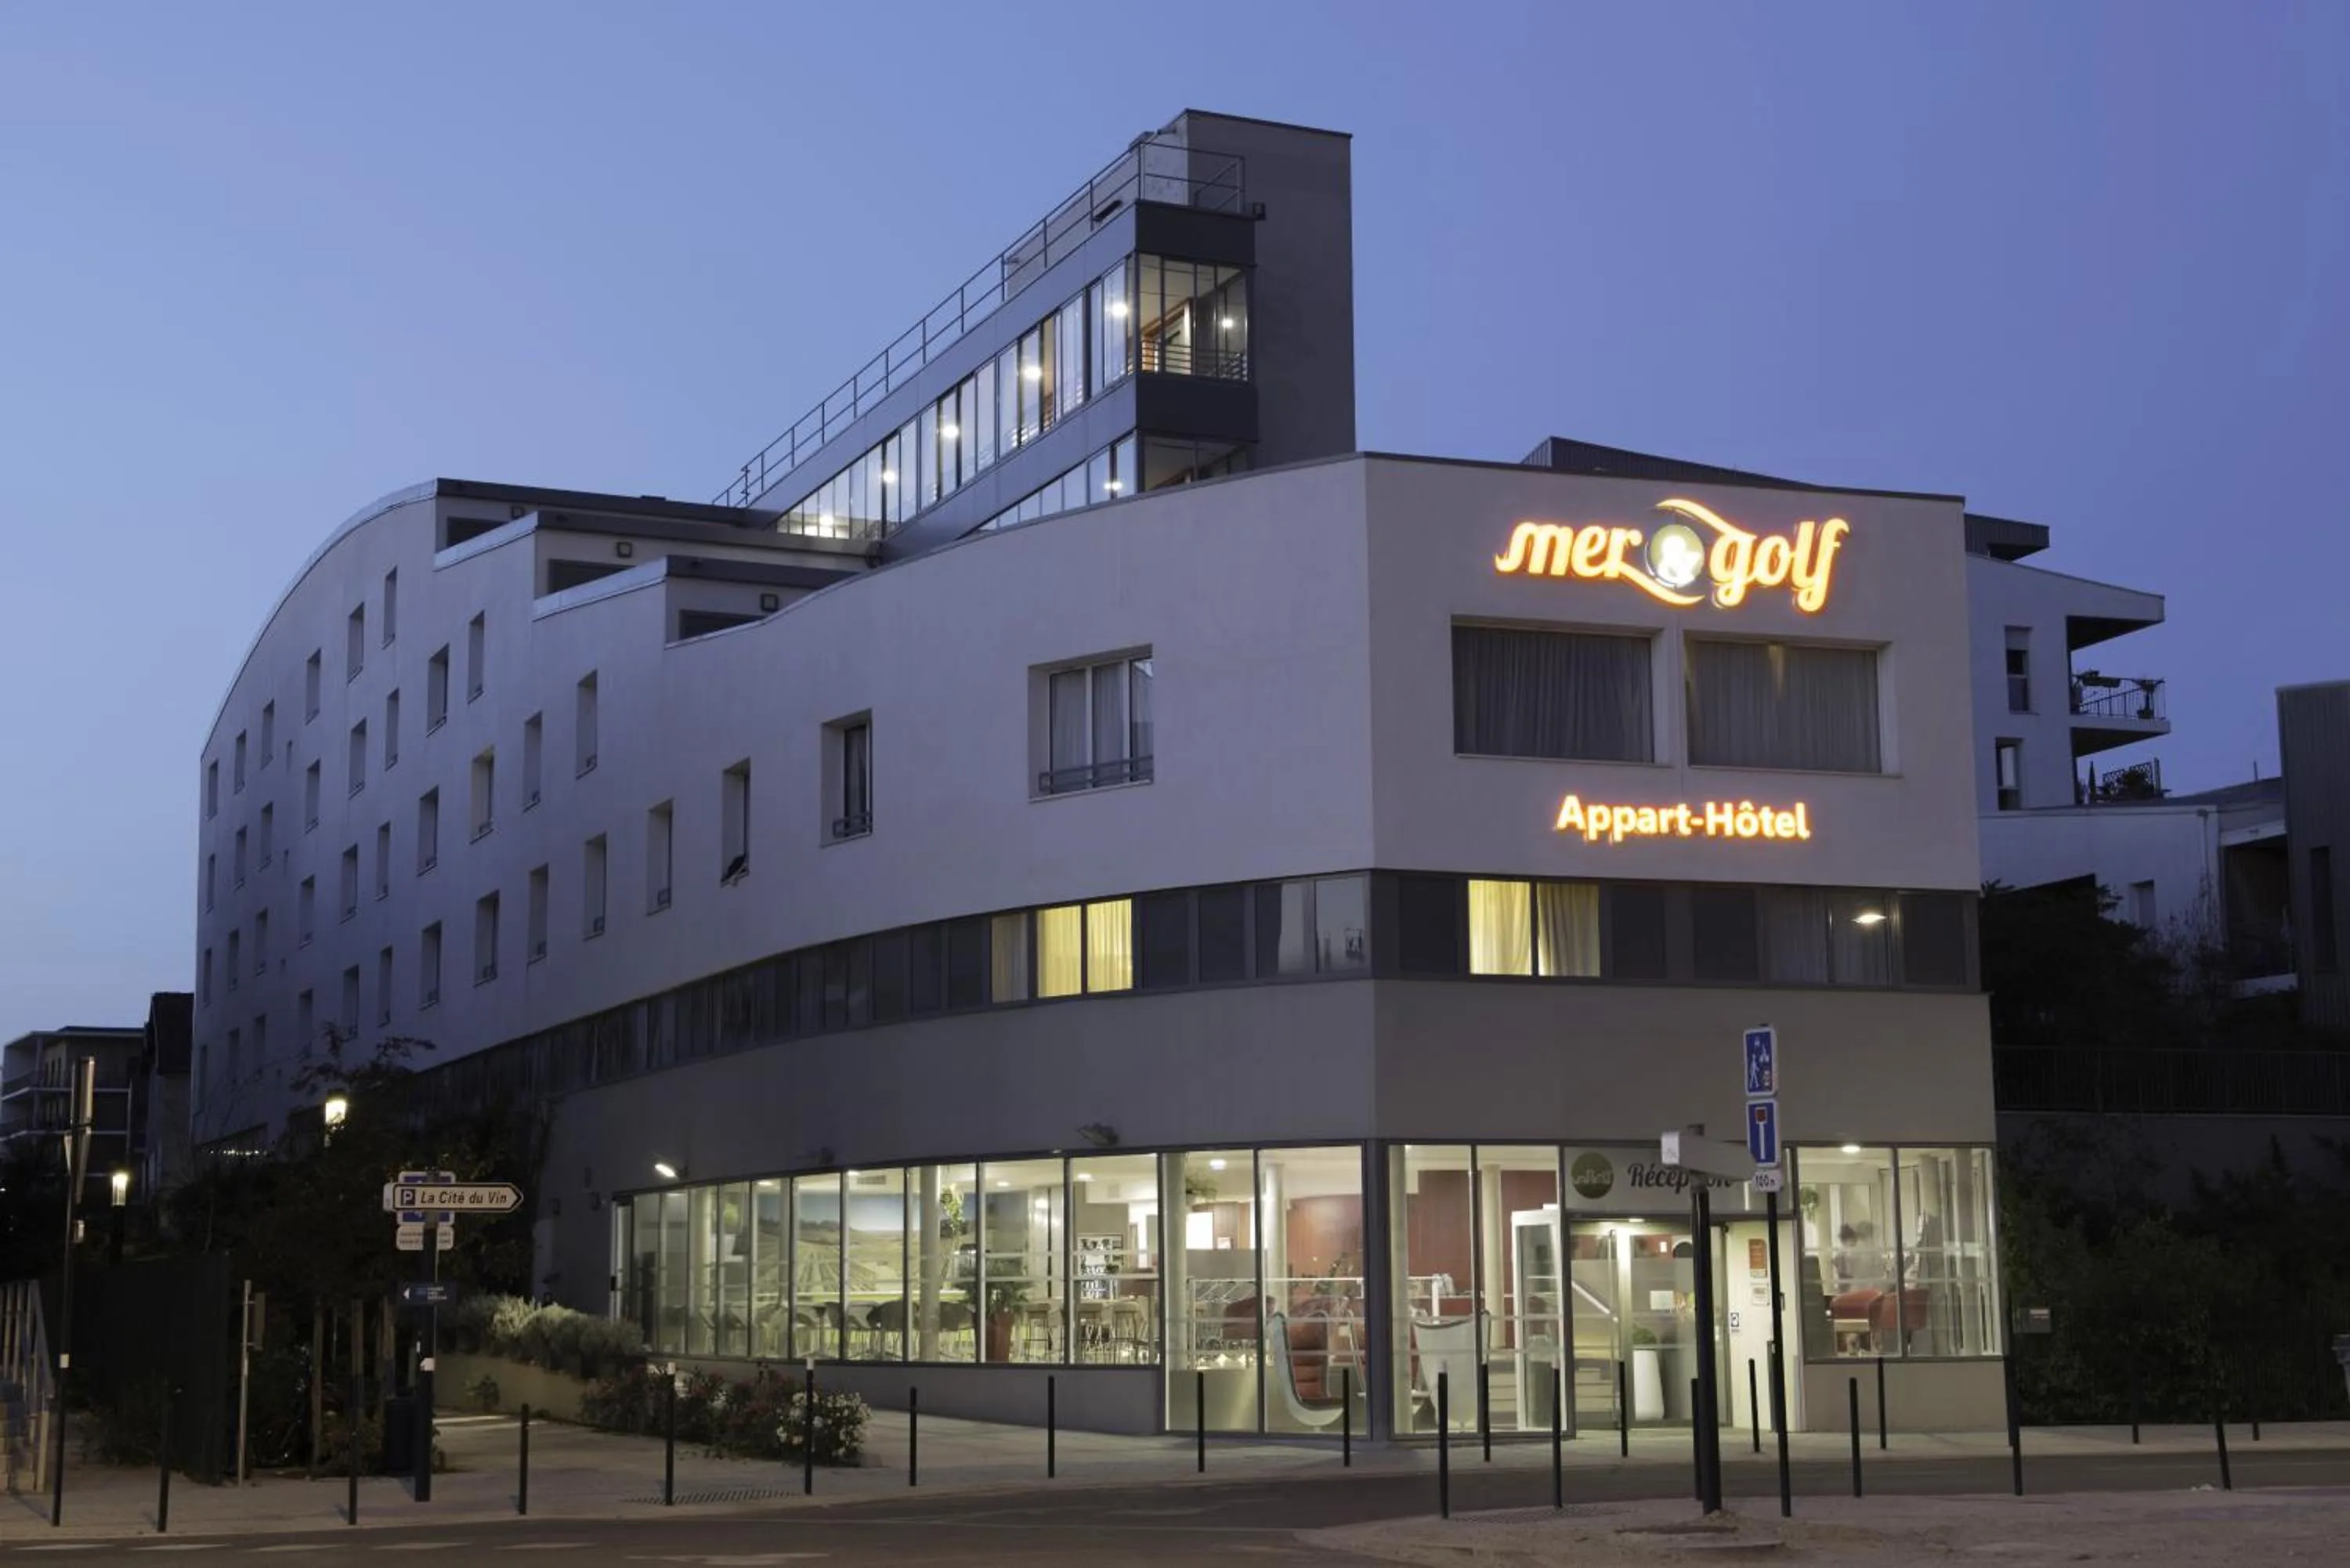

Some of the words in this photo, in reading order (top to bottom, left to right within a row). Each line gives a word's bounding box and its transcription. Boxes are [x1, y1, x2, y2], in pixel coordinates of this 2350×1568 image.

[1655, 499, 1851, 612] golf
[1555, 794, 1811, 843] Appart-Hôtel
[402, 1190, 414, 1204] P
[420, 1190, 435, 1204] La
[438, 1190, 465, 1204] Cité
[468, 1190, 483, 1204] du
[487, 1191, 508, 1204] Vin
[1628, 1162, 1733, 1194] Récepo
